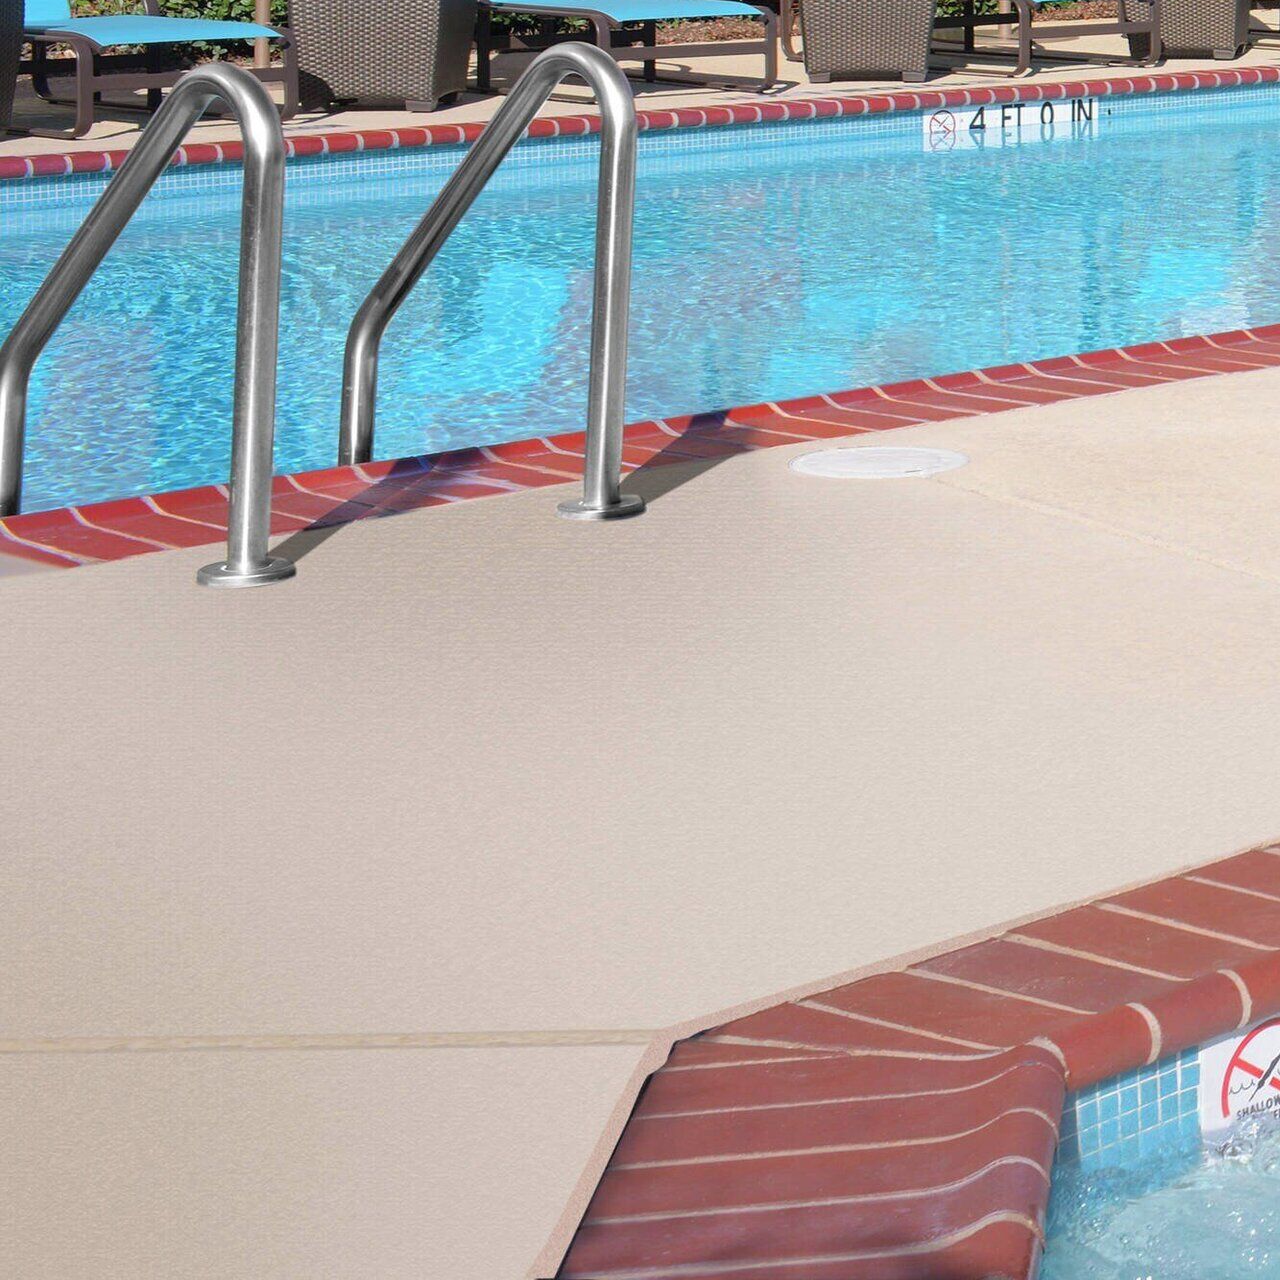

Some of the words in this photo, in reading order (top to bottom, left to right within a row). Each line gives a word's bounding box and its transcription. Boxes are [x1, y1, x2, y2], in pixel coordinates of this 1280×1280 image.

[969, 106, 986, 129] 4
[1001, 103, 1025, 128] FT
[1040, 101, 1054, 124] 0
[1071, 98, 1093, 122] IN
